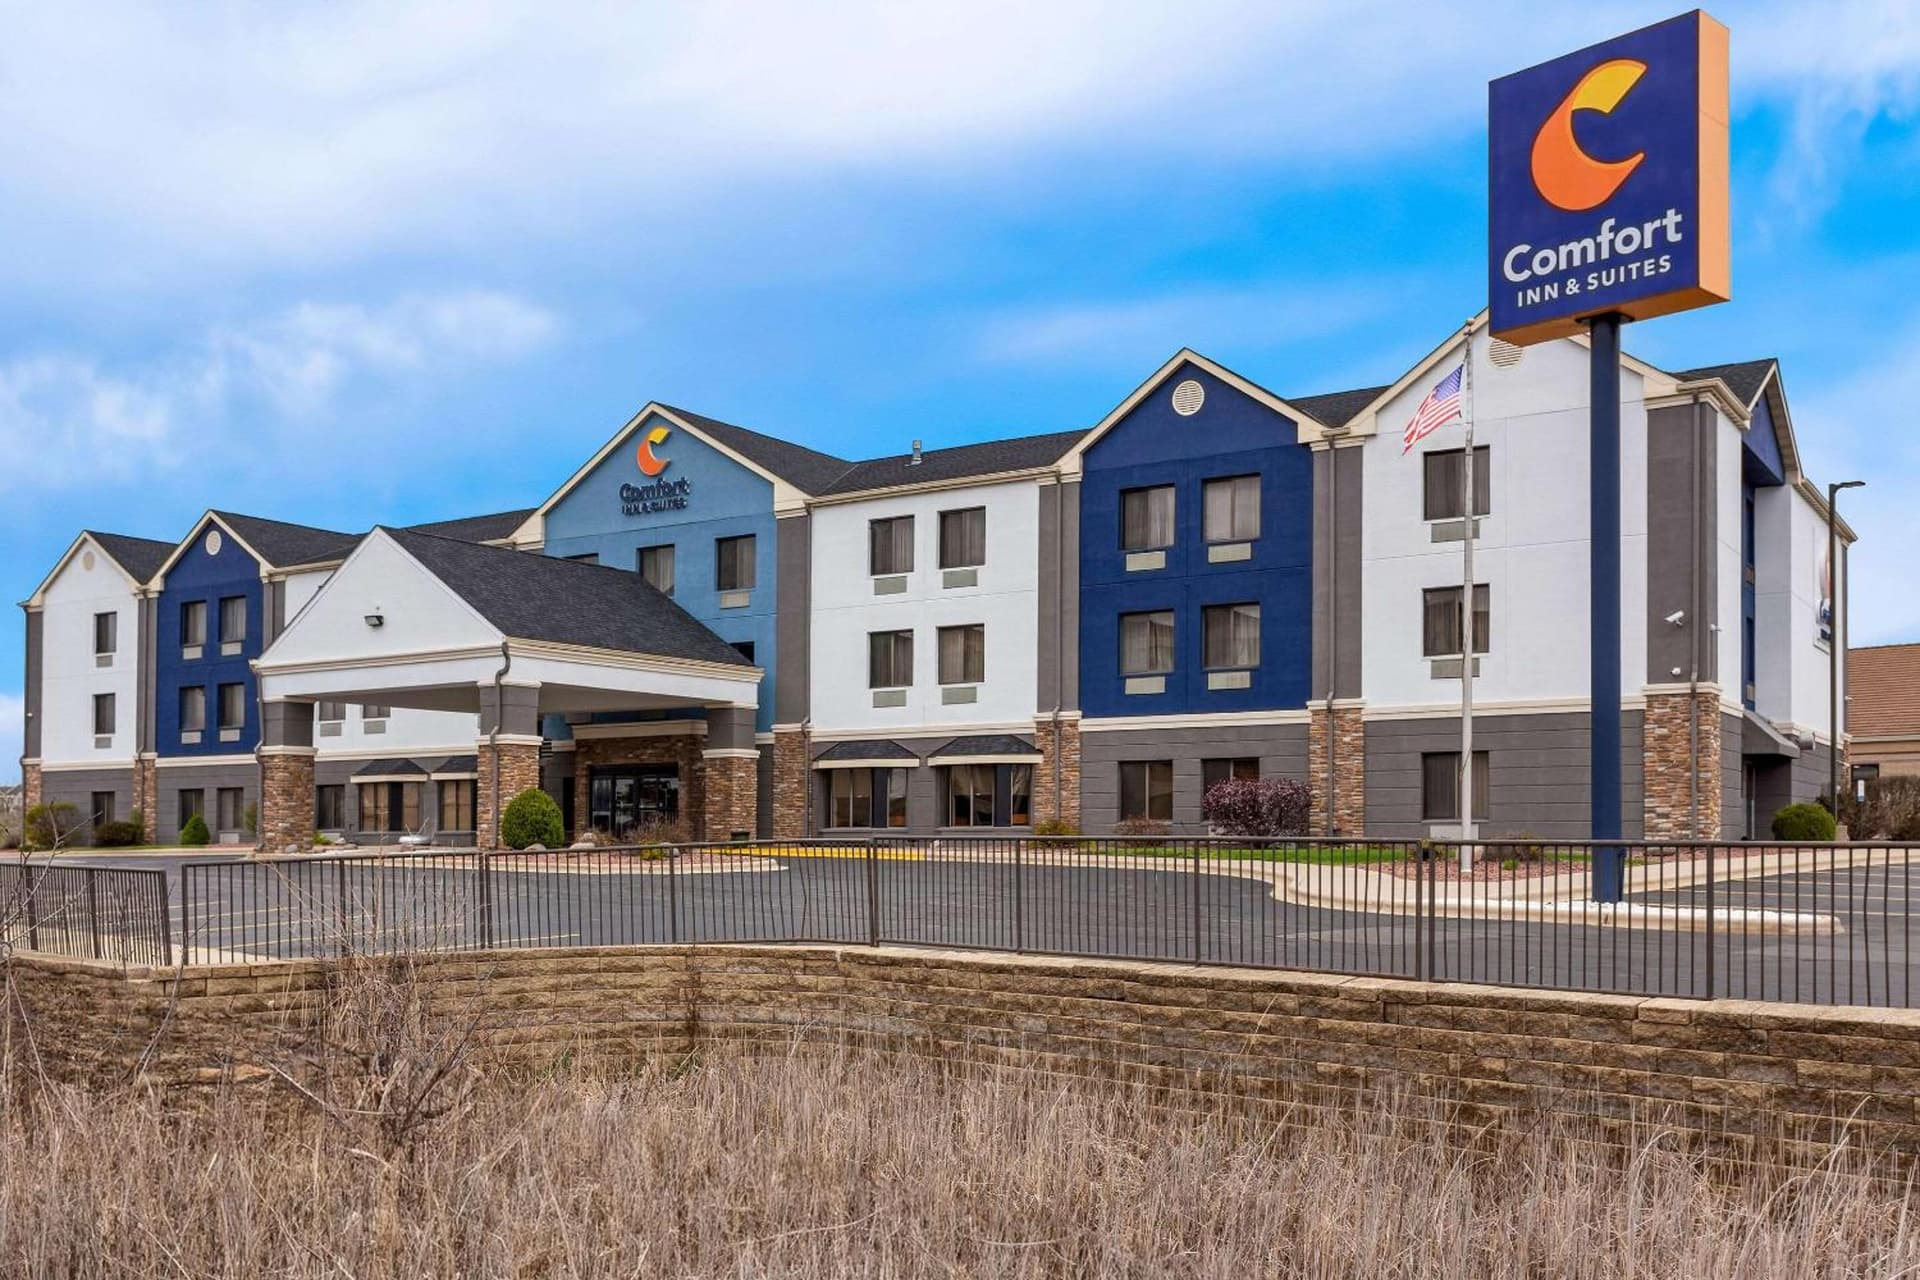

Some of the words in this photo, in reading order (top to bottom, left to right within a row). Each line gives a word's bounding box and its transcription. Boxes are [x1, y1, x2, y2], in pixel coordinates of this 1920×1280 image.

[1503, 208, 1683, 283] Comfort
[1517, 282, 1559, 309] INN
[1565, 278, 1581, 296] &
[1587, 255, 1672, 290] SUITES
[620, 477, 691, 502] Comfort
